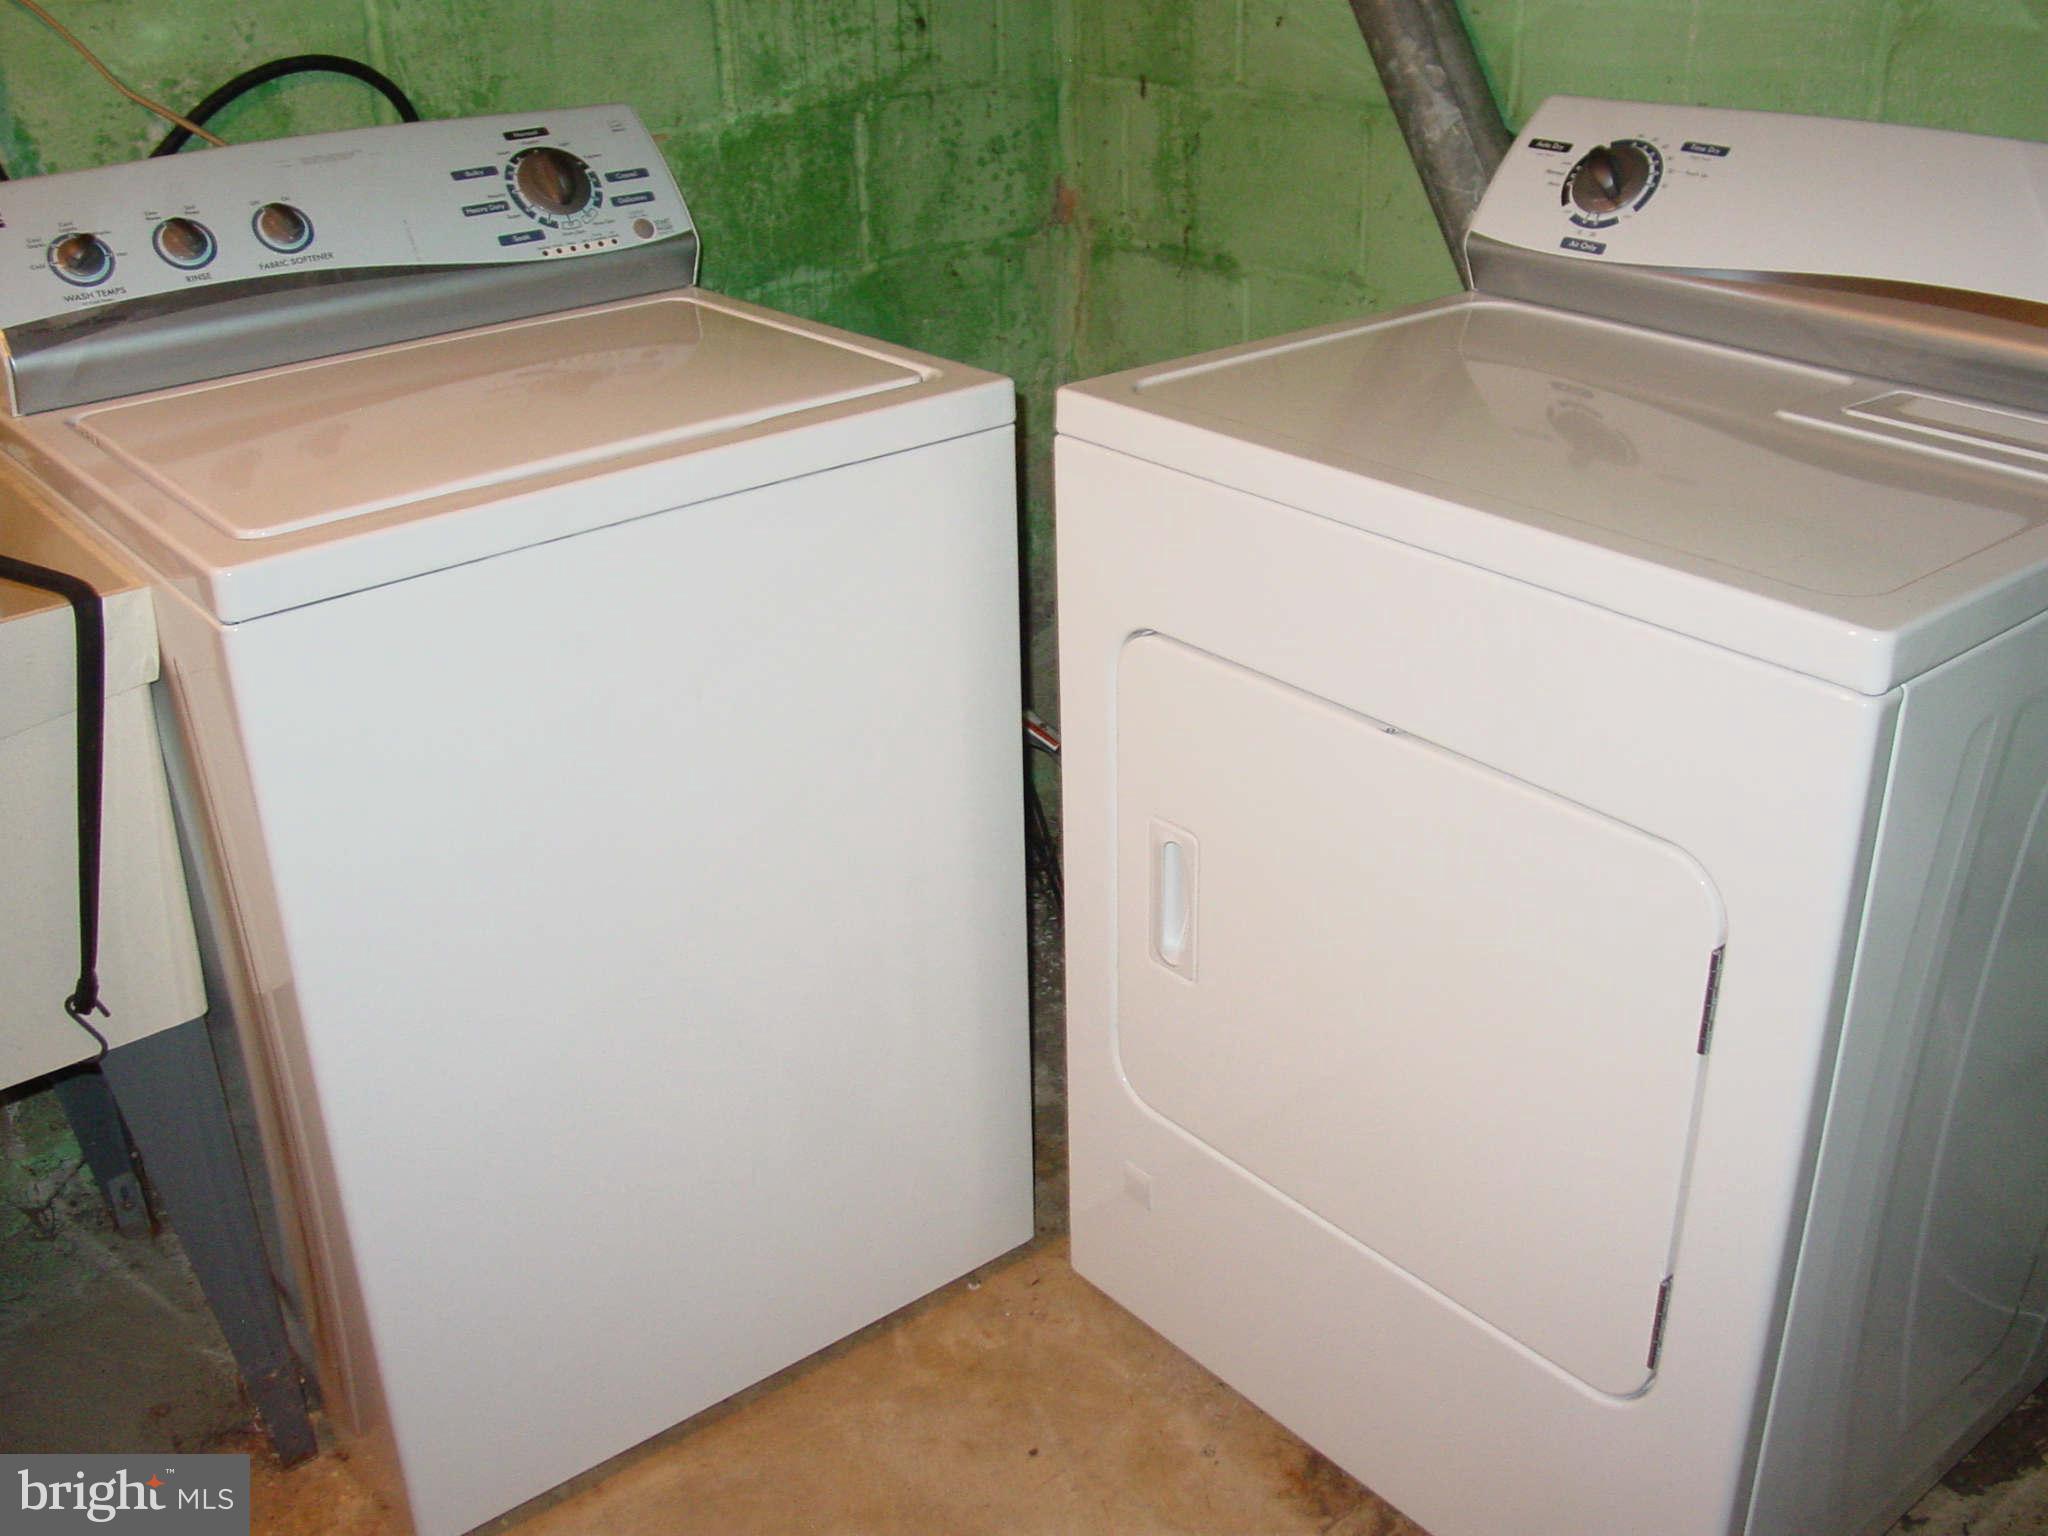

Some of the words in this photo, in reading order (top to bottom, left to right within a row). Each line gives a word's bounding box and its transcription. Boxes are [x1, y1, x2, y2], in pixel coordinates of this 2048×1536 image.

[258, 260, 289, 271] FABRIC
[290, 252, 335, 265] SOFTENER
[185, 272, 212, 283] RINSE
[64, 291, 94, 302] WASH
[95, 287, 127, 297] TEMPS
